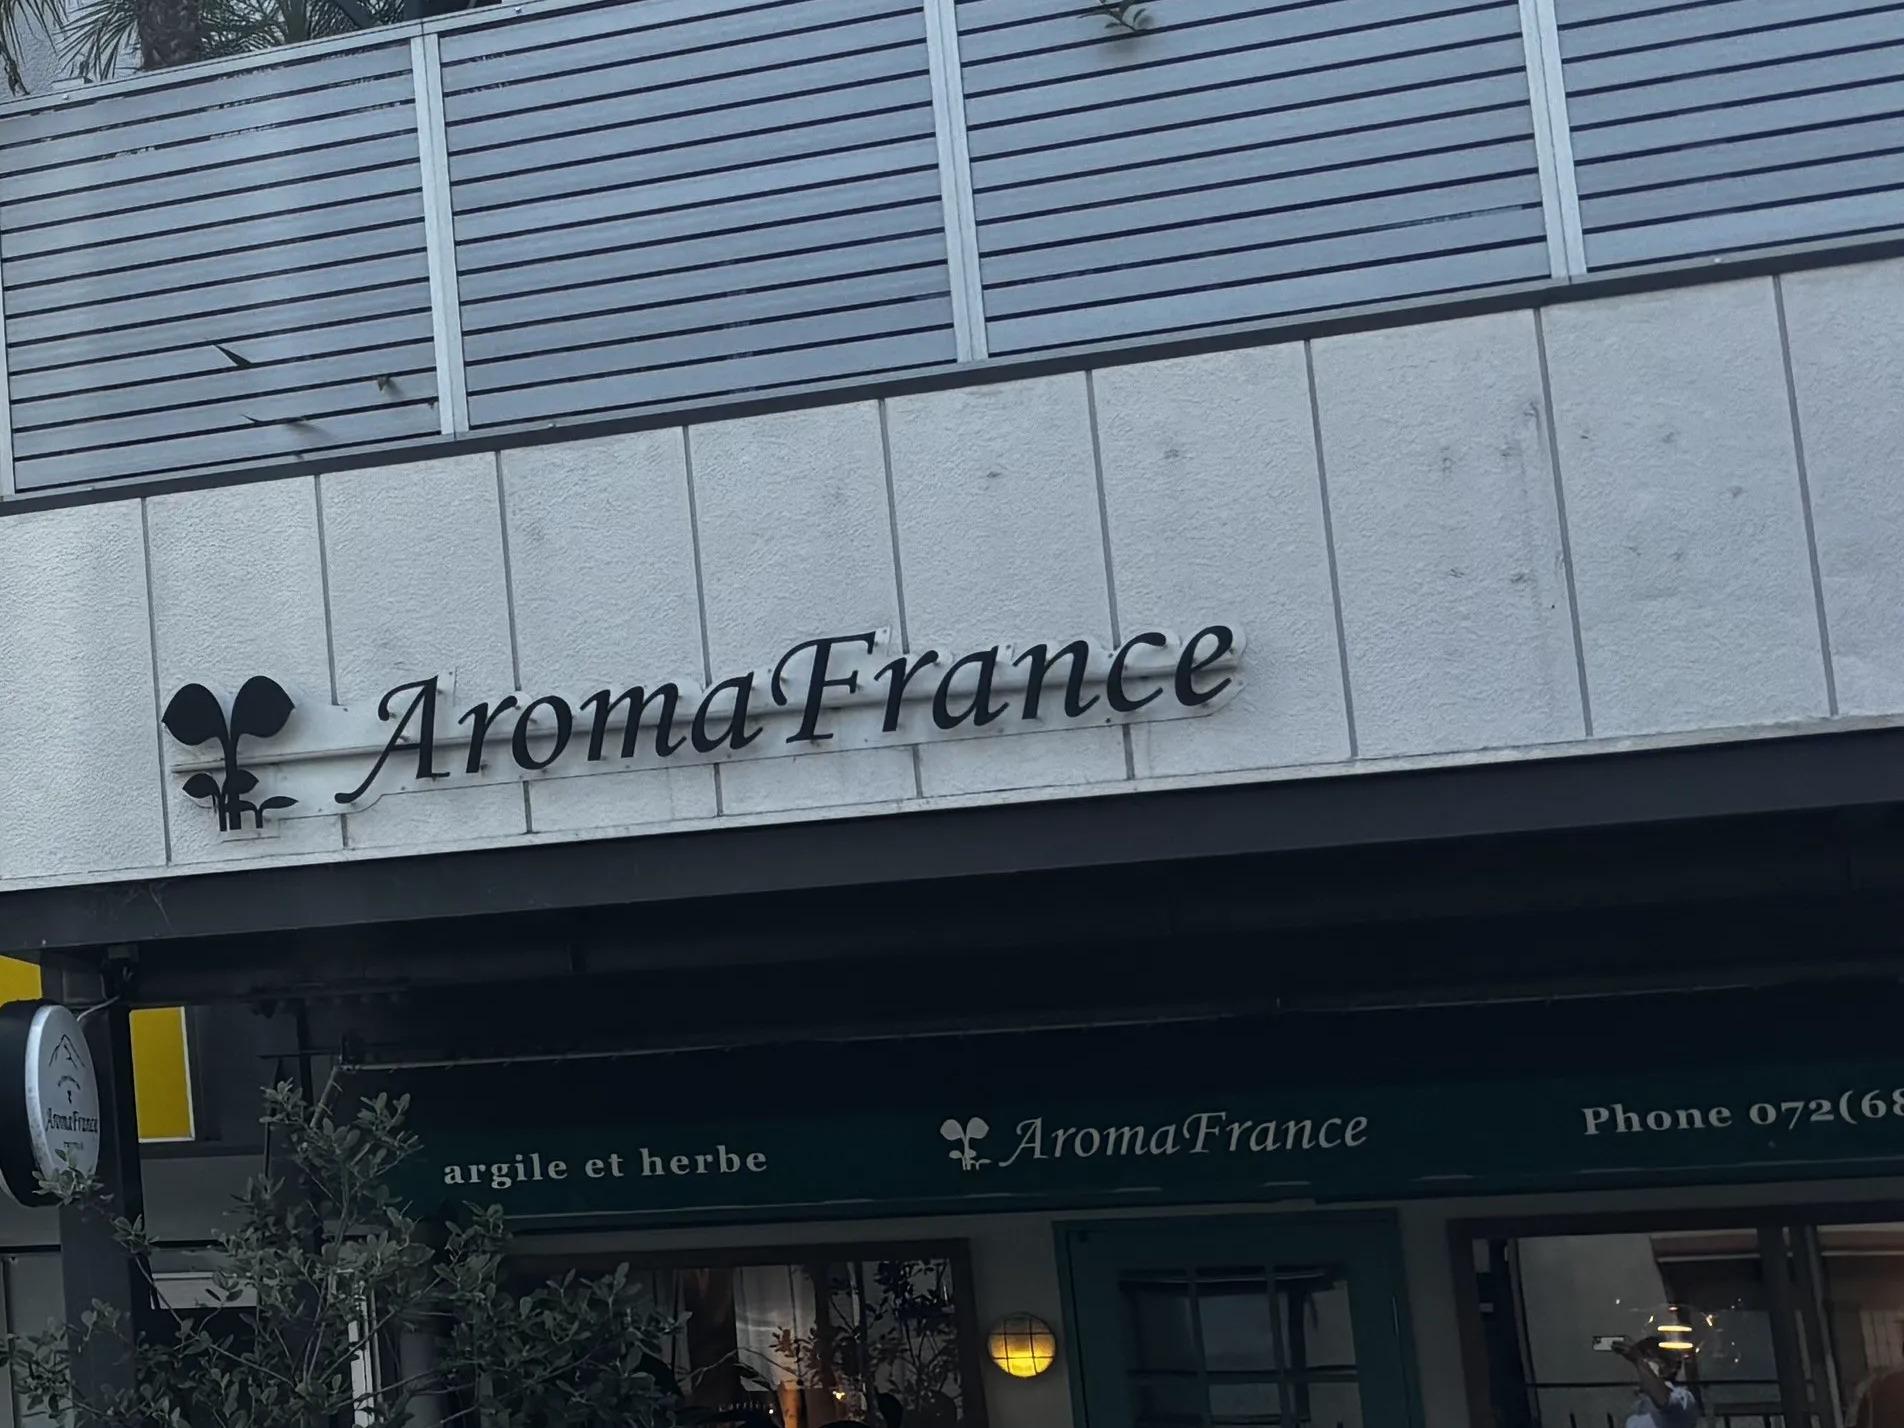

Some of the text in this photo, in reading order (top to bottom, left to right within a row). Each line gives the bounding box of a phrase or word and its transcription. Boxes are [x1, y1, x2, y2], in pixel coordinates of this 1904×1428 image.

[334, 625, 1236, 804] AromaFrance
[999, 1108, 1370, 1167] AromaFrance
[1581, 1103, 1733, 1135] Phone
[443, 1143, 769, 1190] argile et herbe
